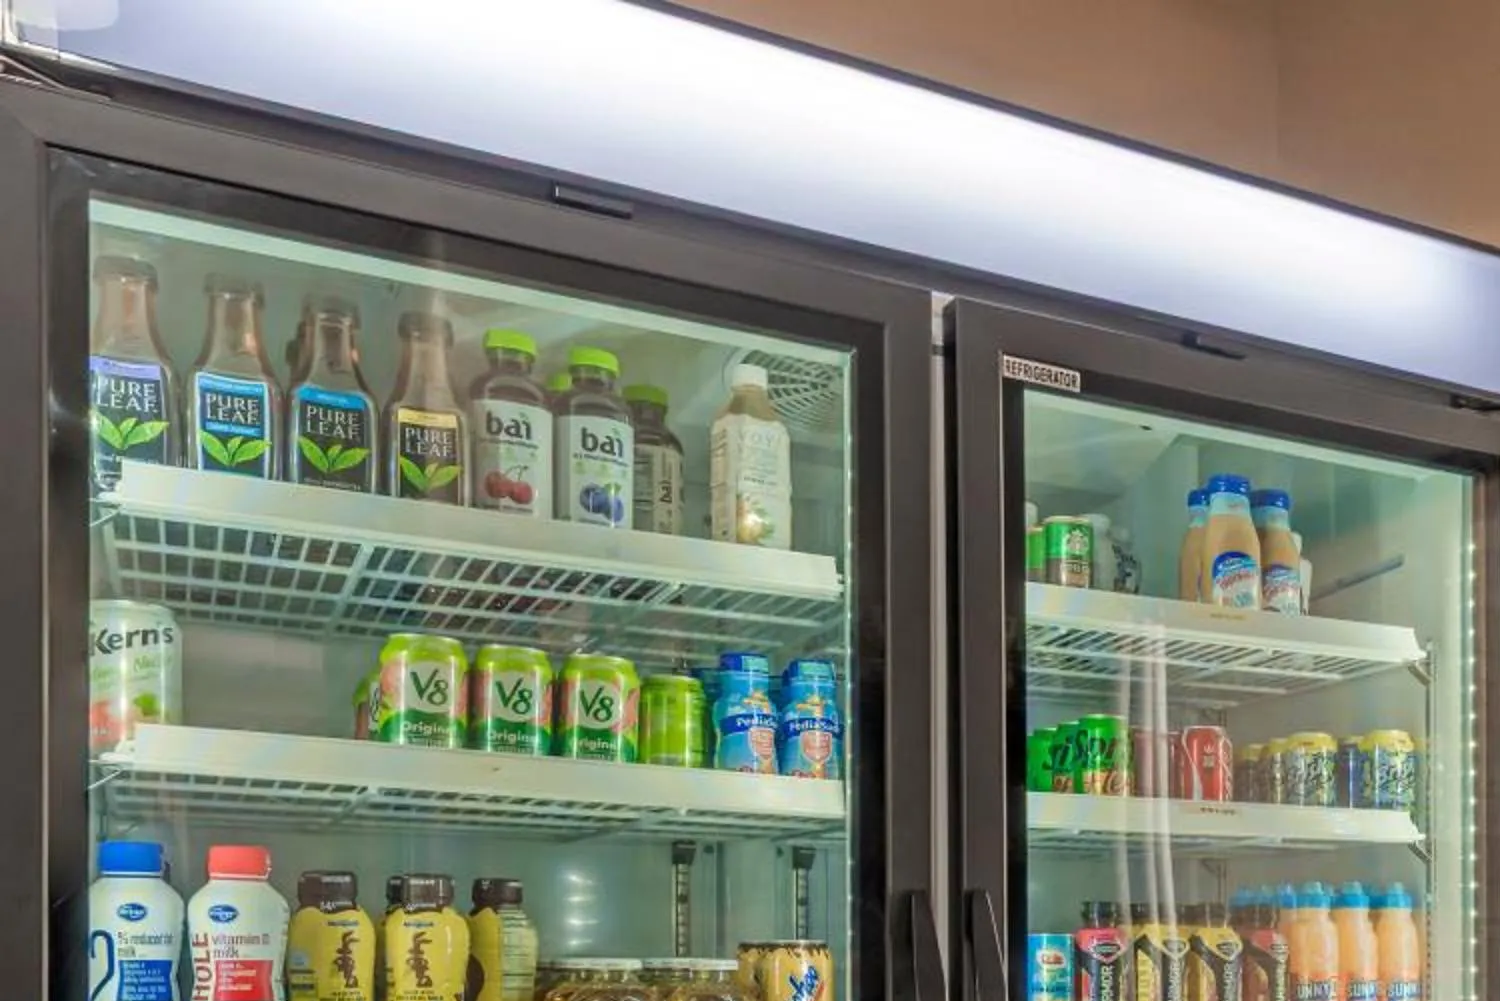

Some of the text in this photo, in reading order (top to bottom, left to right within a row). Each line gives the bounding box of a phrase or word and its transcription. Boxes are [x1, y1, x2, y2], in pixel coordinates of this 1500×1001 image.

[1005, 359, 1078, 388] REFRIGERATOR
[97, 378, 156, 397] PURE
[97, 393, 158, 412] LEAF
[206, 393, 259, 412] PURE
[206, 407, 259, 425] LEAF
[306, 405, 359, 425] PURE
[306, 421, 359, 440] LEAF
[486, 411, 533, 440] bai
[405, 427, 452, 445] PURE
[581, 427, 624, 457] bai
[405, 441, 453, 457] LEAF
[411, 669, 448, 705] V8
[496, 678, 533, 714] V8
[580, 686, 614, 722] V8
